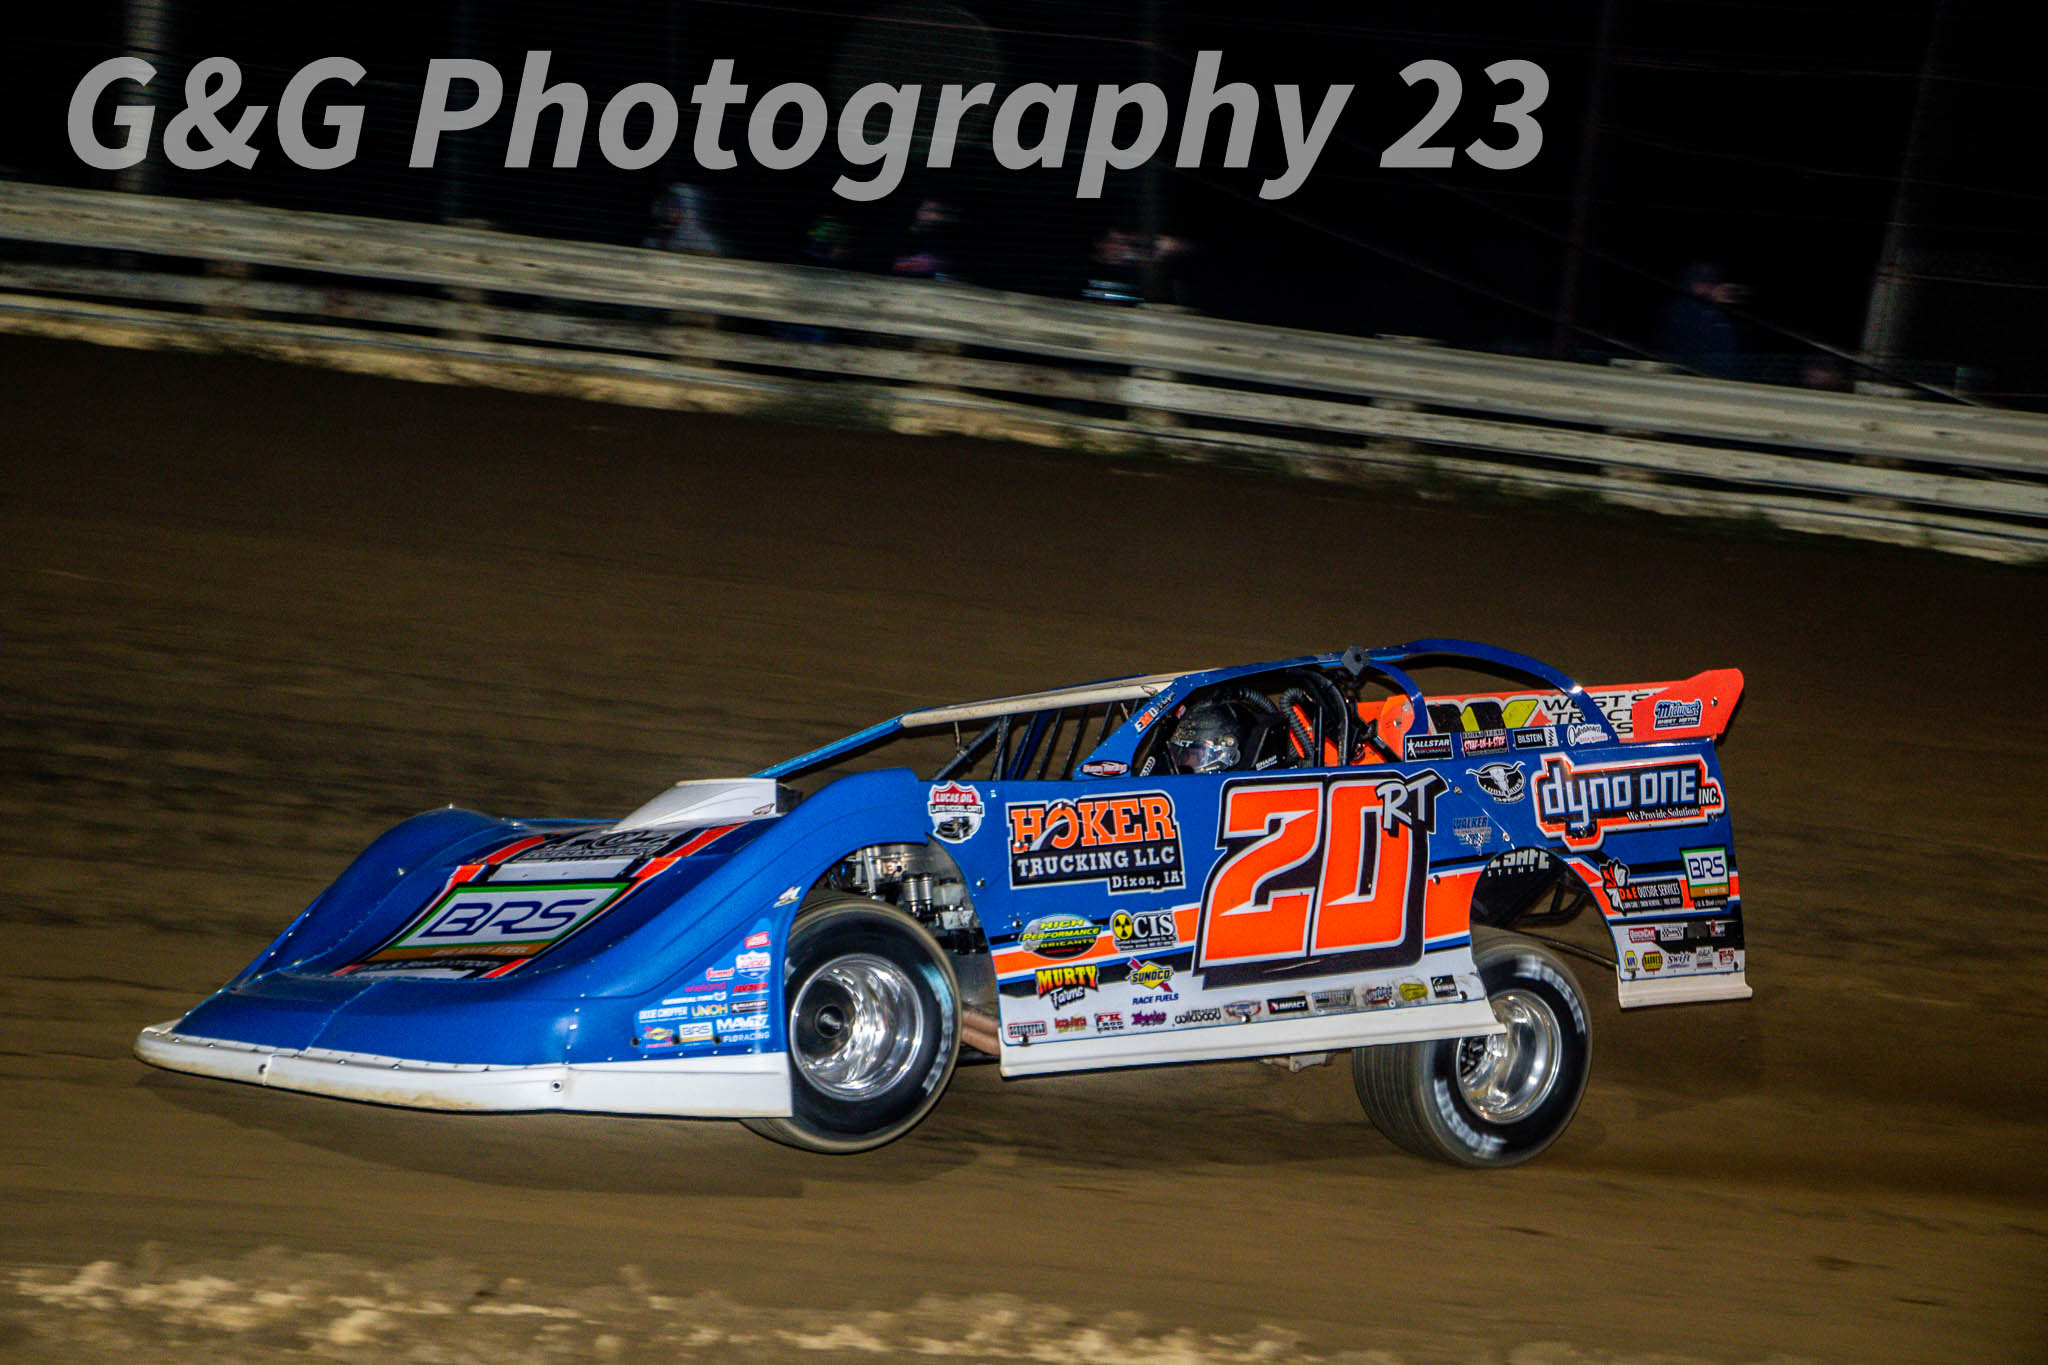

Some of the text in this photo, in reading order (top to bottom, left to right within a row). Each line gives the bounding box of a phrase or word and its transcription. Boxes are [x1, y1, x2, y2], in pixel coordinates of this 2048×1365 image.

[1655, 700, 1700, 718] Midwest
[1414, 738, 1450, 748] ALLSTAR
[1517, 733, 1543, 745] BILSTEIN
[935, 793, 974, 803] LUCAS OIL
[1375, 774, 1441, 831] RT
[1542, 765, 1631, 829] dyno
[1698, 787, 1720, 805] INC.
[1626, 806, 1700, 821] We Provide Solutions
[1011, 796, 1176, 854] HOKER
[1453, 816, 1488, 829] WALKER
[1017, 846, 1175, 878] TRUCKING LLC
[1688, 856, 1726, 879] BRS
[1199, 778, 1413, 968] 20
[1112, 875, 1161, 889] Dixon,
[1637, 884, 1659, 899] OUTSIDE
[1659, 882, 1680, 898] SERVICES
[418, 898, 596, 938] BRS
[1040, 919, 1085, 930] HIGH
[1022, 927, 1100, 941] PERFORMANCE
[1133, 914, 1174, 939] CIS
[1667, 952, 1691, 964] Swift
[1036, 964, 1098, 995] MURTY
[1132, 969, 1171, 983] SUNOCO
[684, 982, 727, 992] wieland
[1050, 986, 1086, 1010] Farms
[1131, 993, 1180, 1006] RACE FUELS
[690, 1003, 729, 1017] UNOH
[1174, 1007, 1222, 1024] wilwood
